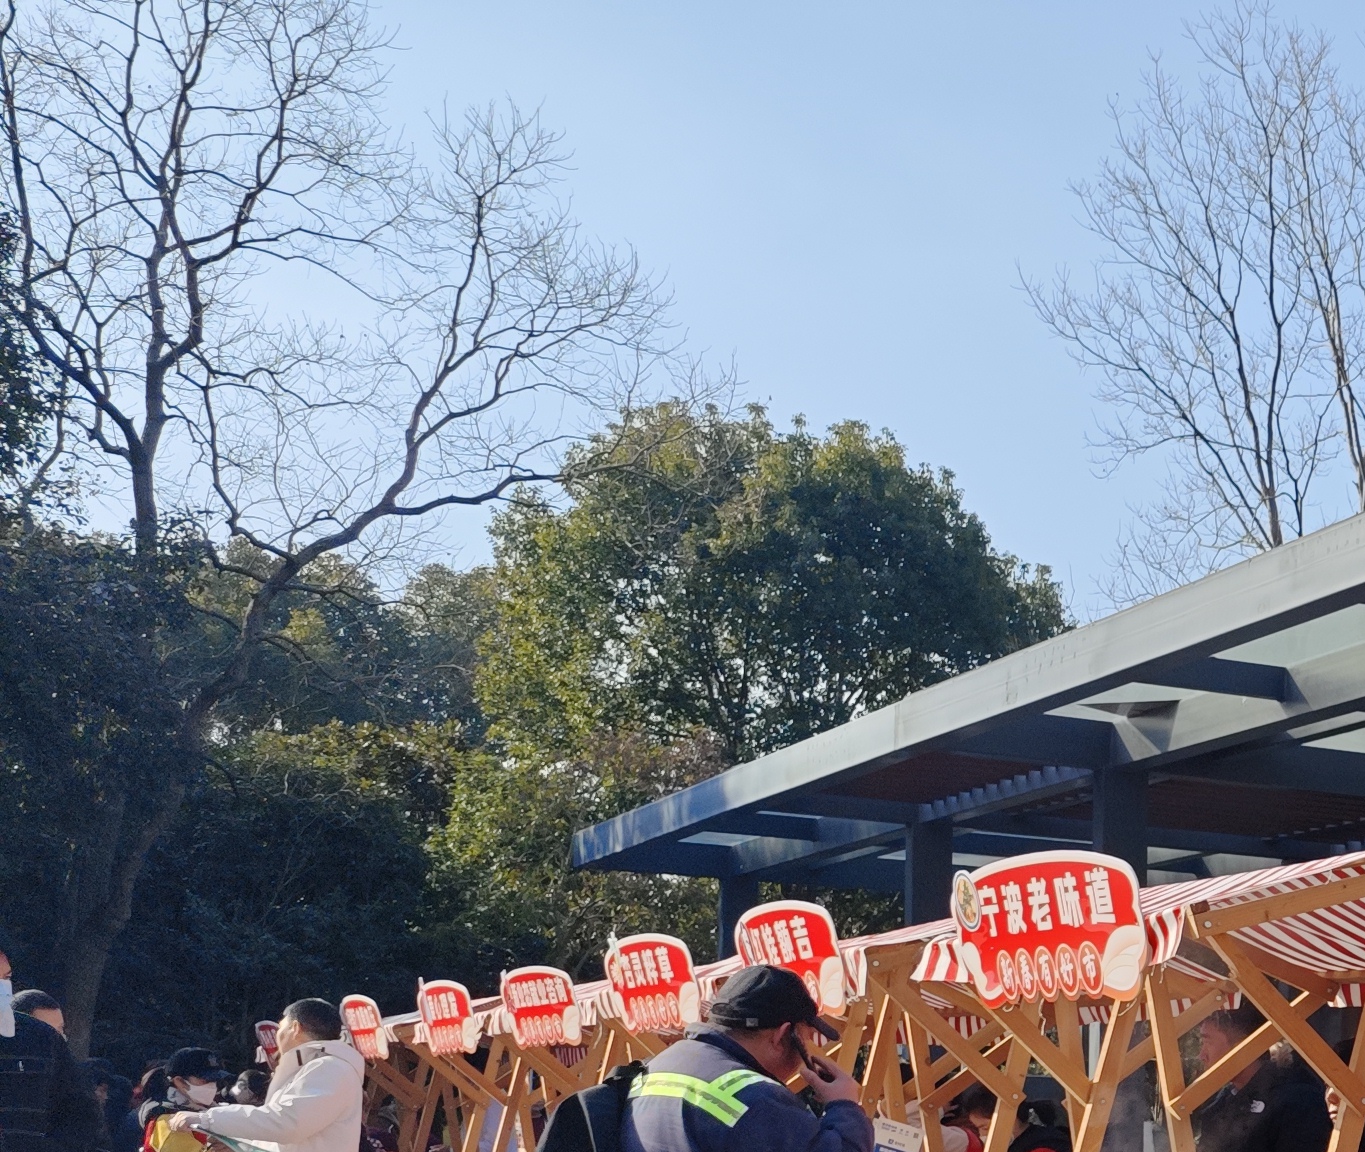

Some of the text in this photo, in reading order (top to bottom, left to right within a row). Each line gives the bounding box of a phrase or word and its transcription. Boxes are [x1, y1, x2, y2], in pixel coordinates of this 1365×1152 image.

[978, 867, 1116, 937] 宁波老味道
[1000, 948, 1096, 991] 新春有好市
